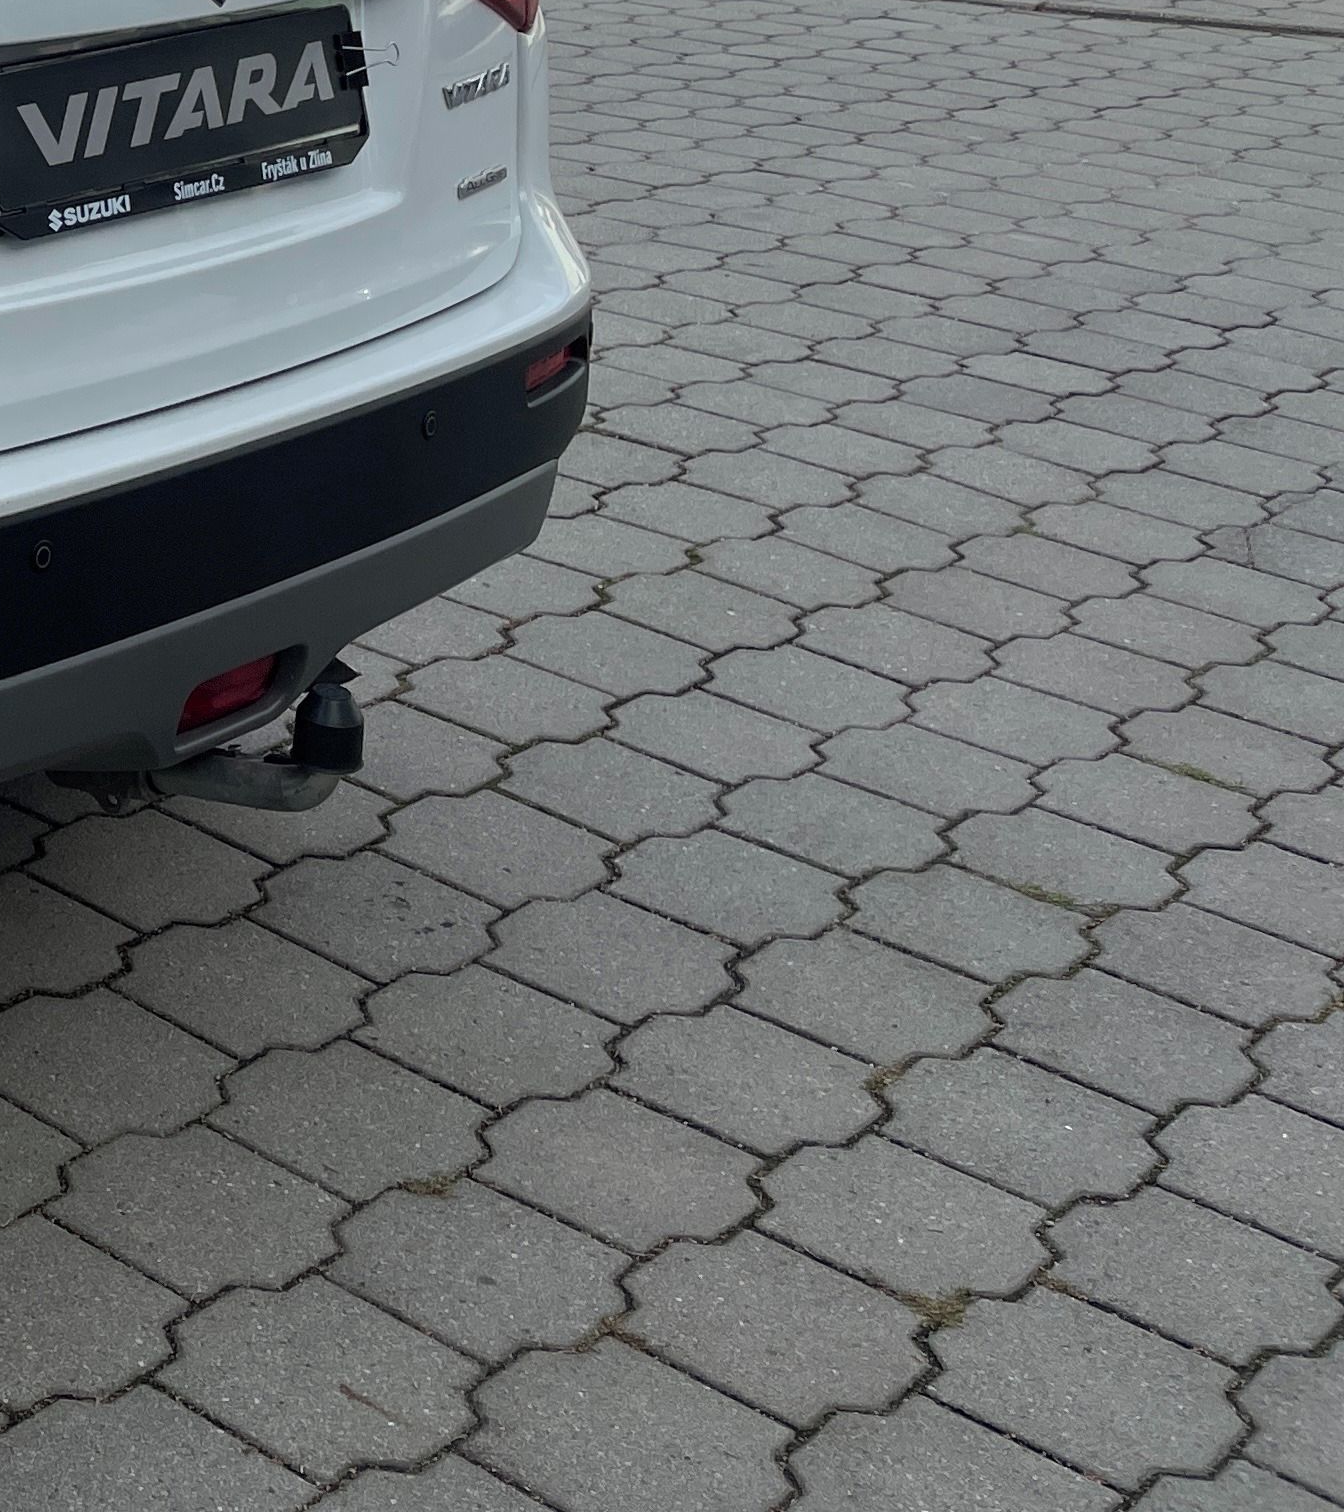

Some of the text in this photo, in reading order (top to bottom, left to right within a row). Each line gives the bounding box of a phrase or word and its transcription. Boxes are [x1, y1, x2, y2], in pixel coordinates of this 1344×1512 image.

[16, 40, 336, 167] VITARA
[261, 147, 333, 181] Fryšták u Zlína
[173, 173, 225, 201] Simcar.Cz
[63, 194, 131, 227] SUZUKI
